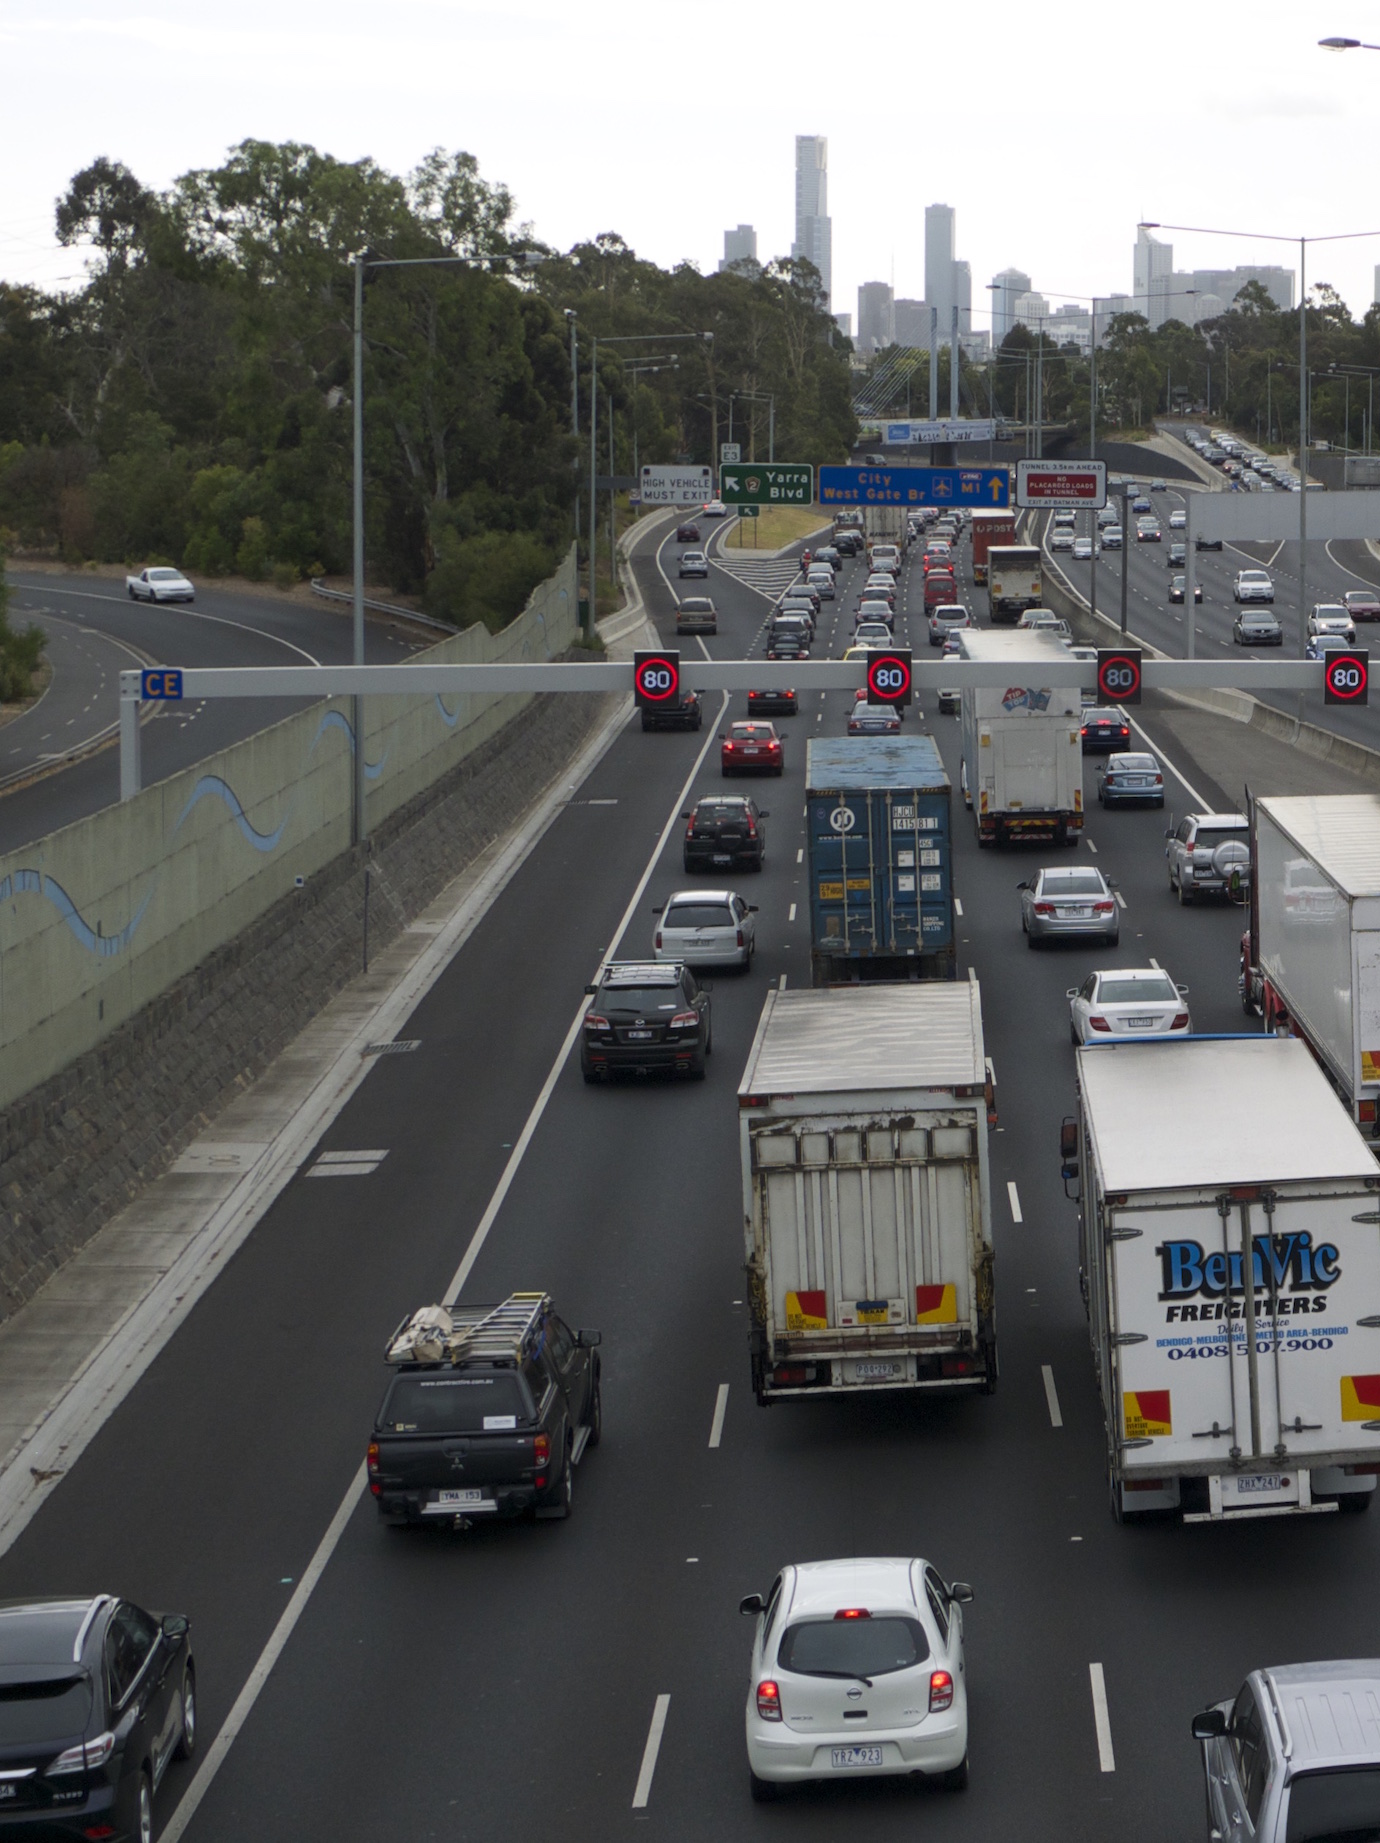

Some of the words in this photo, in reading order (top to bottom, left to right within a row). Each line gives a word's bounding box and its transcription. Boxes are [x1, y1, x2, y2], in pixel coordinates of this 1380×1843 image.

[724, 452, 738, 461] E3
[642, 478, 665, 487] HIGH
[670, 479, 710, 488] VEHICLE
[765, 472, 808, 483] Yarra
[858, 473, 891, 486] City
[769, 487, 804, 498] Blvd
[823, 488, 858, 499] West
[866, 488, 901, 500] Gate
[908, 490, 926, 500] Br
[961, 483, 980, 493] M1
[644, 491, 676, 500] MUST
[683, 491, 709, 500] EXIT
[644, 671, 670, 688] 80
[877, 669, 902, 687] 80
[1107, 669, 1132, 686] 80
[1334, 669, 1359, 686] 80
[146, 674, 178, 696] CE
[893, 806, 914, 817] HJCU
[1156, 1230, 1342, 1302] BenVic
[1167, 1345, 1230, 1361] 0408
[834, 1750, 853, 1763] YRZ
[861, 1749, 881, 1761] 923
